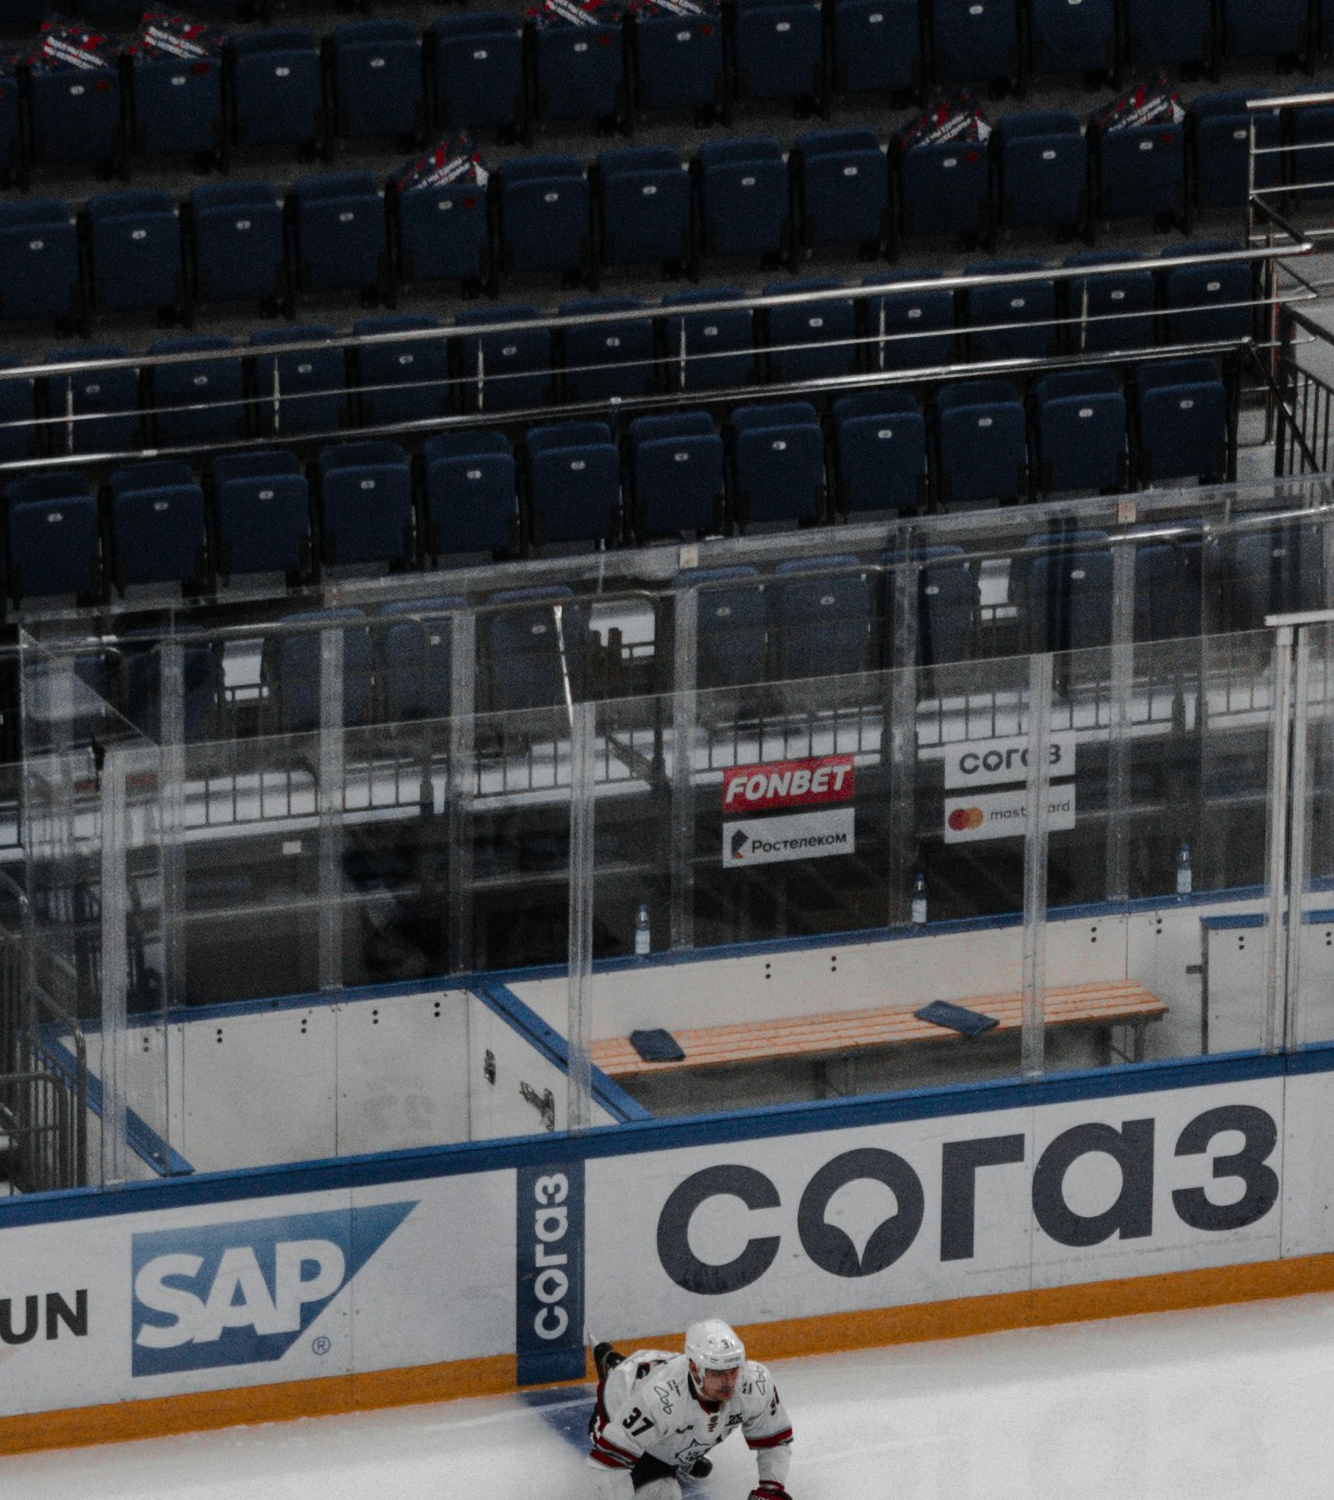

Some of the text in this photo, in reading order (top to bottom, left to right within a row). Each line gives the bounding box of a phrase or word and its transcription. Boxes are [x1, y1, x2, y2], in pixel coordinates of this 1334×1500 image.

[726, 764, 853, 804] FONBET
[752, 833, 847, 854] Ростелеком
[135, 1238, 346, 1349] SAP
[623, 1407, 654, 1437] 37
